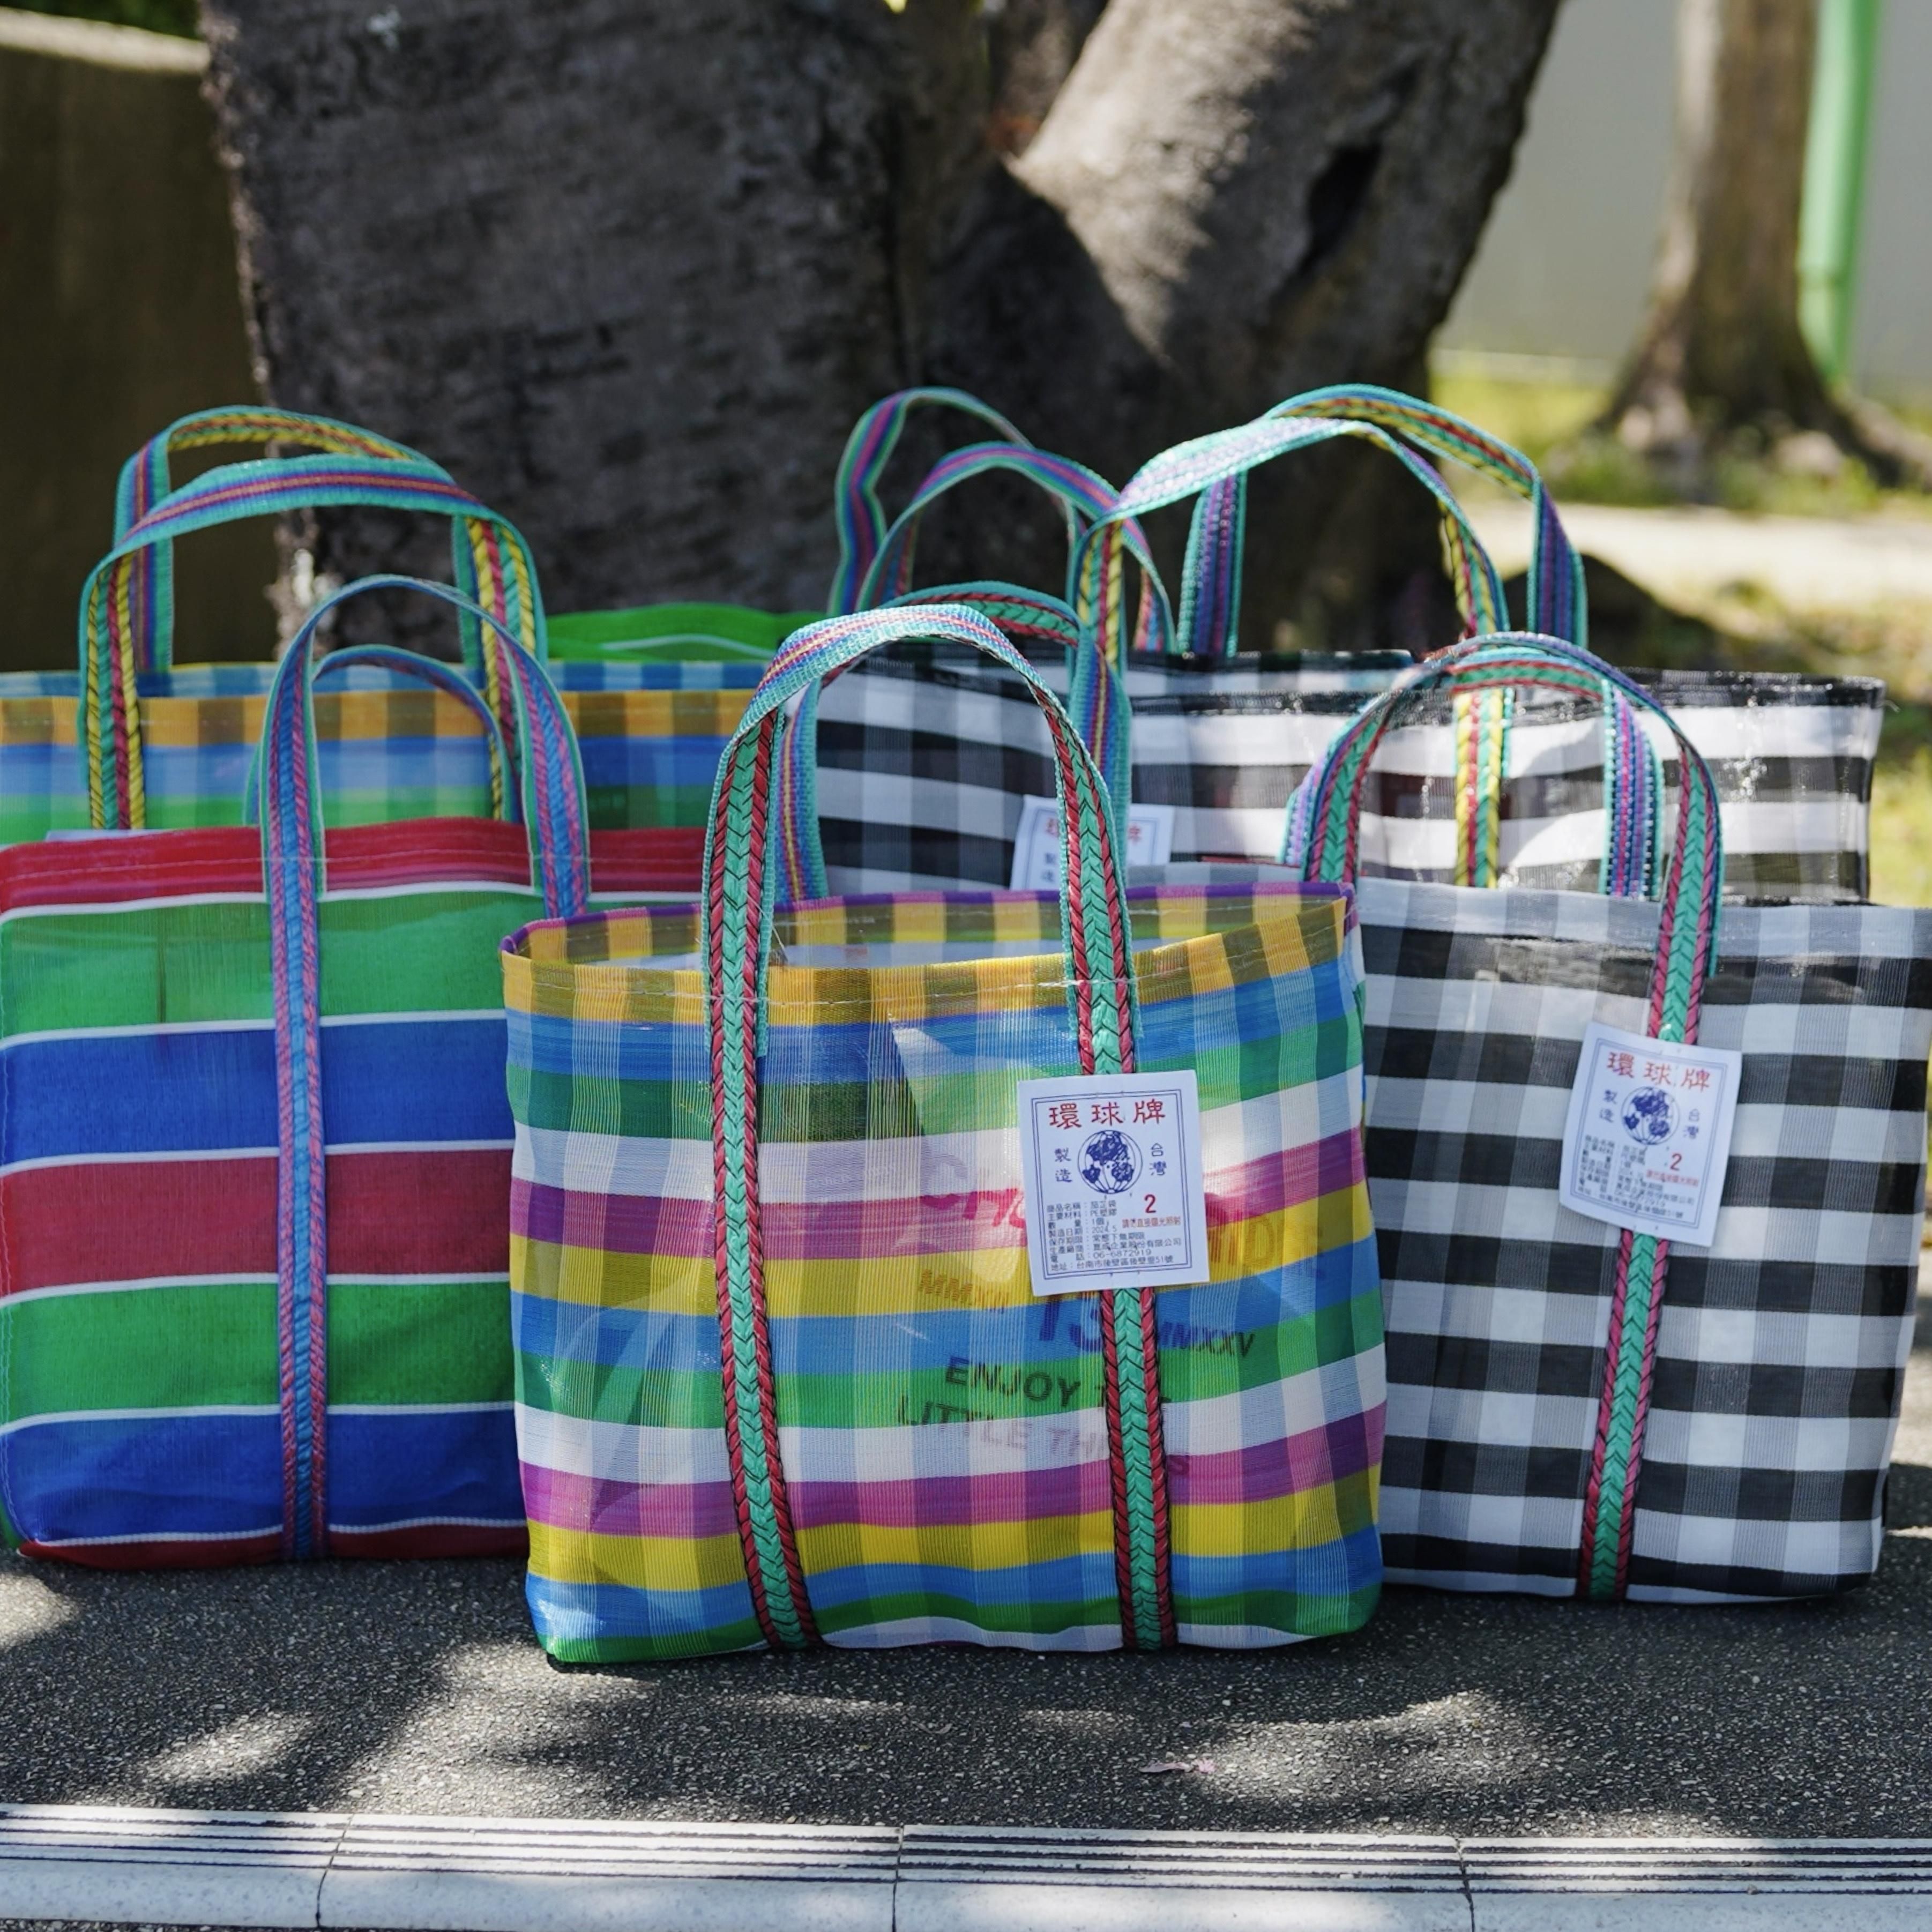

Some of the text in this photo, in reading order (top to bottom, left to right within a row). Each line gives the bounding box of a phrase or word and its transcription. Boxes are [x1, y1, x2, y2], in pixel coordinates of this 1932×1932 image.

[1606, 1051, 1711, 1092] 環球牌
[1048, 1099, 1166, 1130] 環球牌
[1054, 1147, 1072, 1183] 製造
[1149, 1142, 1167, 1176] 台灣
[1670, 1153, 1682, 1171] 2
[1144, 1193, 1157, 1214] 2
[945, 1354, 1081, 1407] ENJOY
[898, 1393, 1031, 1450] LITTLE
